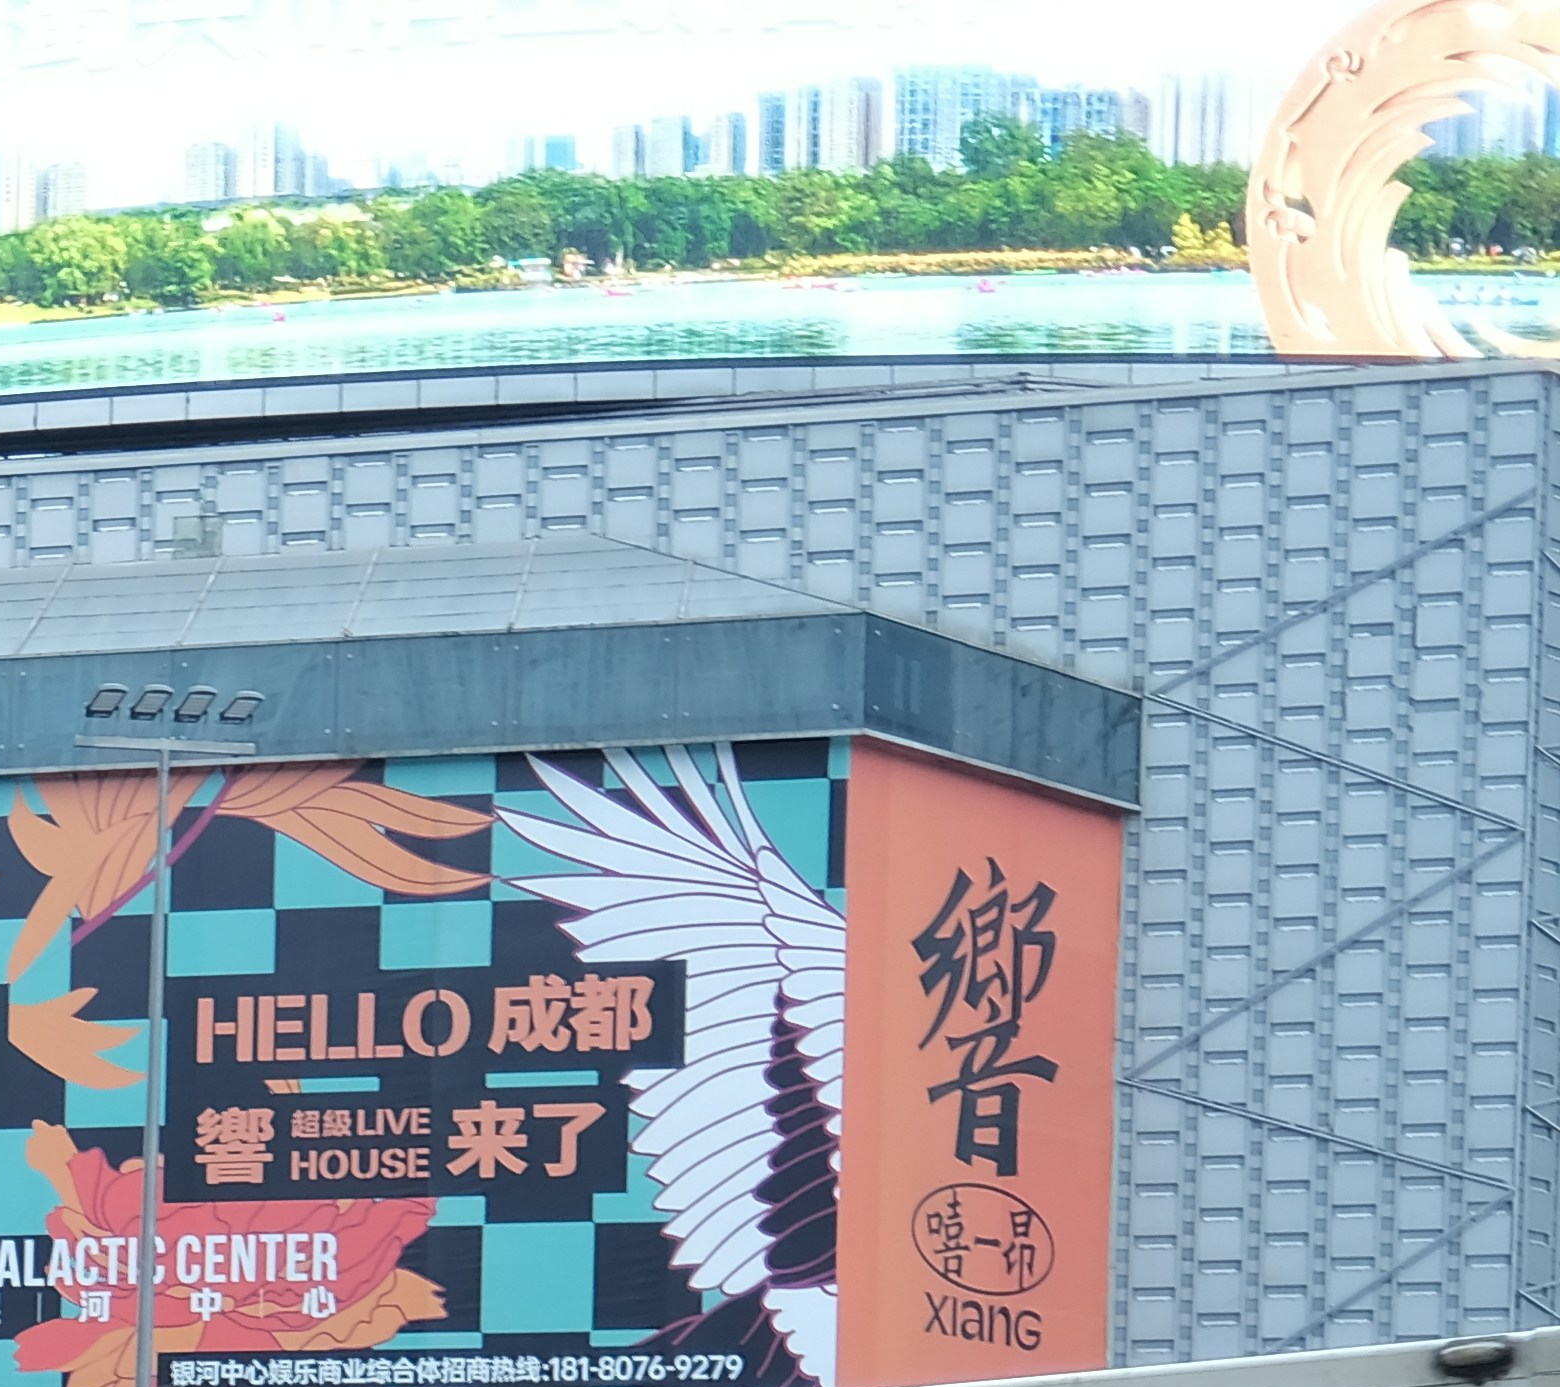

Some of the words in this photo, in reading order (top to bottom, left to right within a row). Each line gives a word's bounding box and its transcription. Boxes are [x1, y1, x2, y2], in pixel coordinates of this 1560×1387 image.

[195, 988, 471, 1064] HELLO
[488, 973, 656, 1056] 成都
[290, 1147, 431, 1180] HOUSE
[446, 1100, 607, 1179] 来了
[176, 1232, 338, 1284] CENTER
